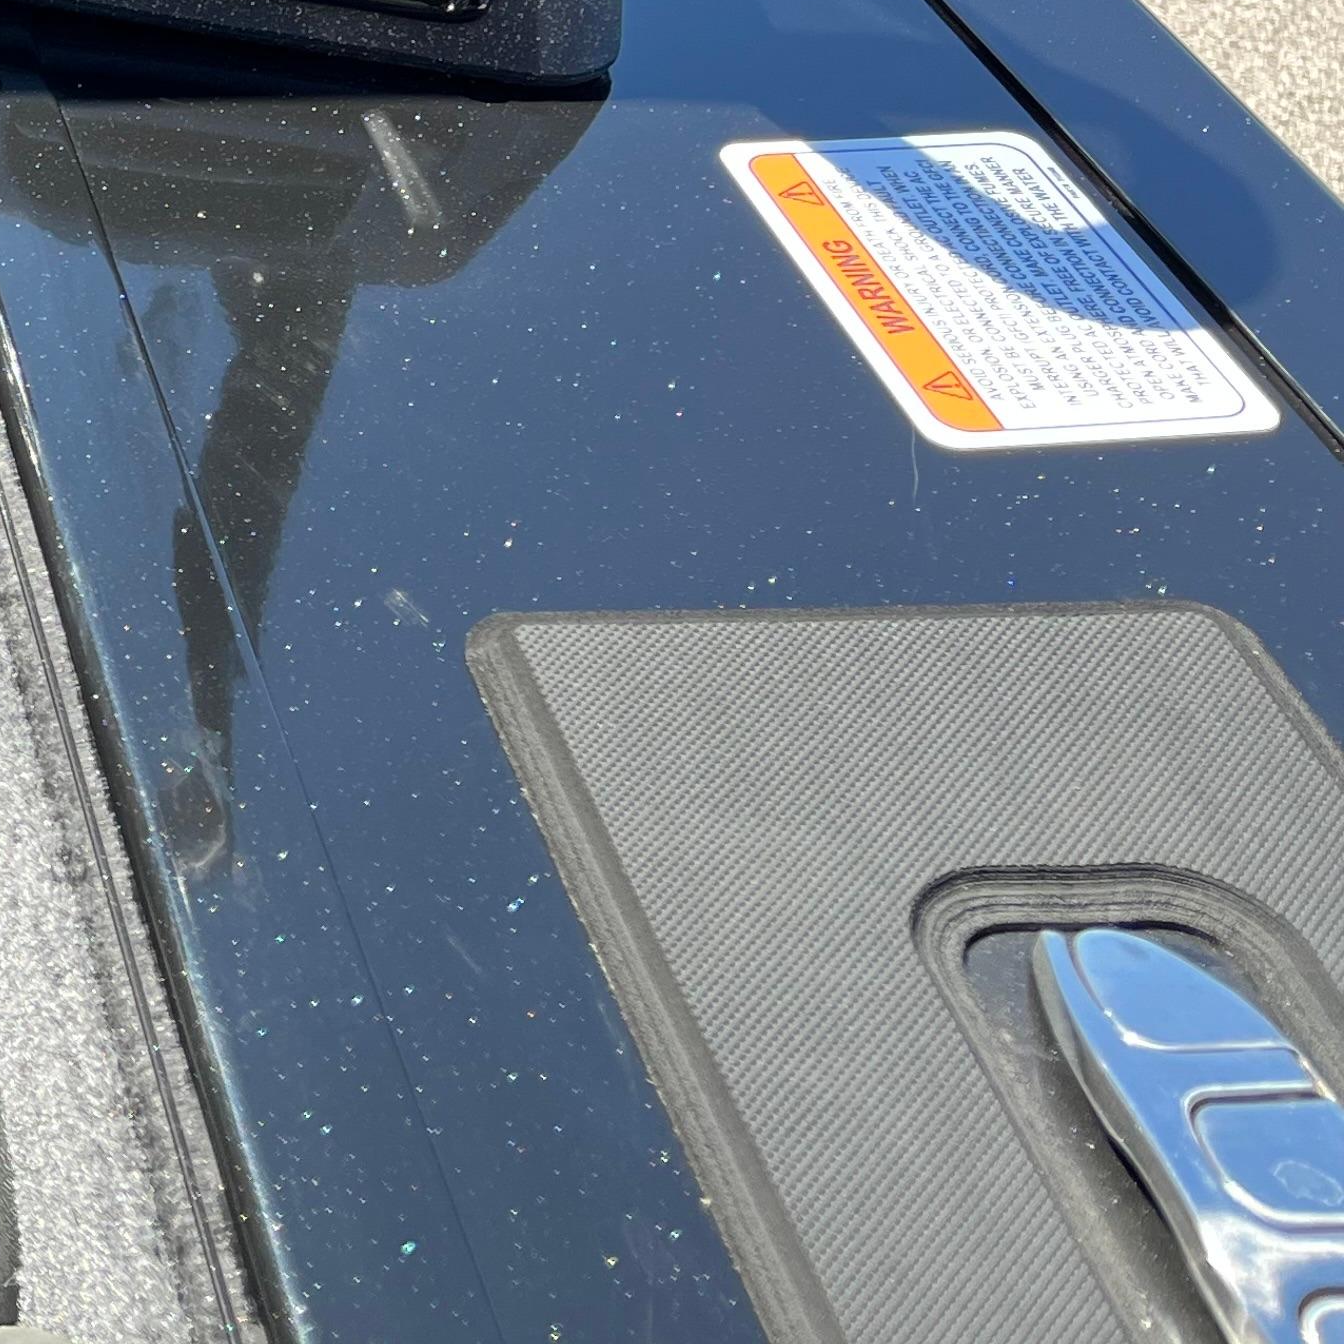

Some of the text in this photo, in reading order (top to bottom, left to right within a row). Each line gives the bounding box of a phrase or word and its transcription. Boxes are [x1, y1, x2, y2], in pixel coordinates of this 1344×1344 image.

[876, 166, 910, 193] WHEN
[938, 160, 960, 172] AN
[950, 174, 970, 184] IN
[979, 156, 1022, 194] MANNER
[834, 167, 872, 199] DEVICE
[866, 180, 902, 209] FAULT
[839, 201, 868, 226] FROM
[862, 202, 888, 222] THIS
[962, 186, 1022, 247] CONNECTION
[993, 196, 1048, 248] EXPLOSIVE
[1014, 197, 1058, 235] SECURE
[1042, 202, 1068, 220] THE
[890, 210, 934, 251] GROUND
[933, 235, 957, 249] AC
[1048, 237, 1069, 246] IN
[1059, 222, 1092, 247] WITH
[862, 230, 897, 262] DEATH
[1037, 251, 1060, 264] OF
[888, 264, 910, 278] OR
[933, 264, 952, 276] TO
[1012, 249, 1048, 276] MAKE
[1082, 249, 1134, 295] CONTACT
[823, 240, 913, 333] WARNING
[902, 170, 1100, 396] USING AN EXTENSION CORD, CONNECT THE AC
[914, 159, 1134, 408] CHARGER PLUG BEFORE CONNECTING TO THE GFCI
[946, 251, 1004, 310] PROTECTED
[1050, 266, 1084, 292] FREE
[1059, 248, 1125, 313] CONNECTION
[902, 282, 938, 316] INJURY
[914, 264, 970, 324] ELECTRICAL
[946, 279, 1006, 341] CONNECTED
[1124, 297, 1162, 328] AVOID
[961, 328, 984, 342] OR
[1076, 324, 1098, 337] AC
[1116, 315, 1145, 336] AND
[931, 319, 977, 364] SERIOUS
[998, 346, 1020, 358] BE
[1138, 339, 1174, 369] CORD
[1155, 330, 1185, 355] WILL
[968, 368, 1004, 400] AVOID
[1012, 362, 1045, 390] MUST
[1023, 348, 1080, 405] INTERRUPT
[1090, 340, 1153, 404] PROTECTED
[1140, 370, 1176, 399] OPEN
[1178, 360, 1210, 385] THAT
[1166, 374, 1201, 402] MAKE
